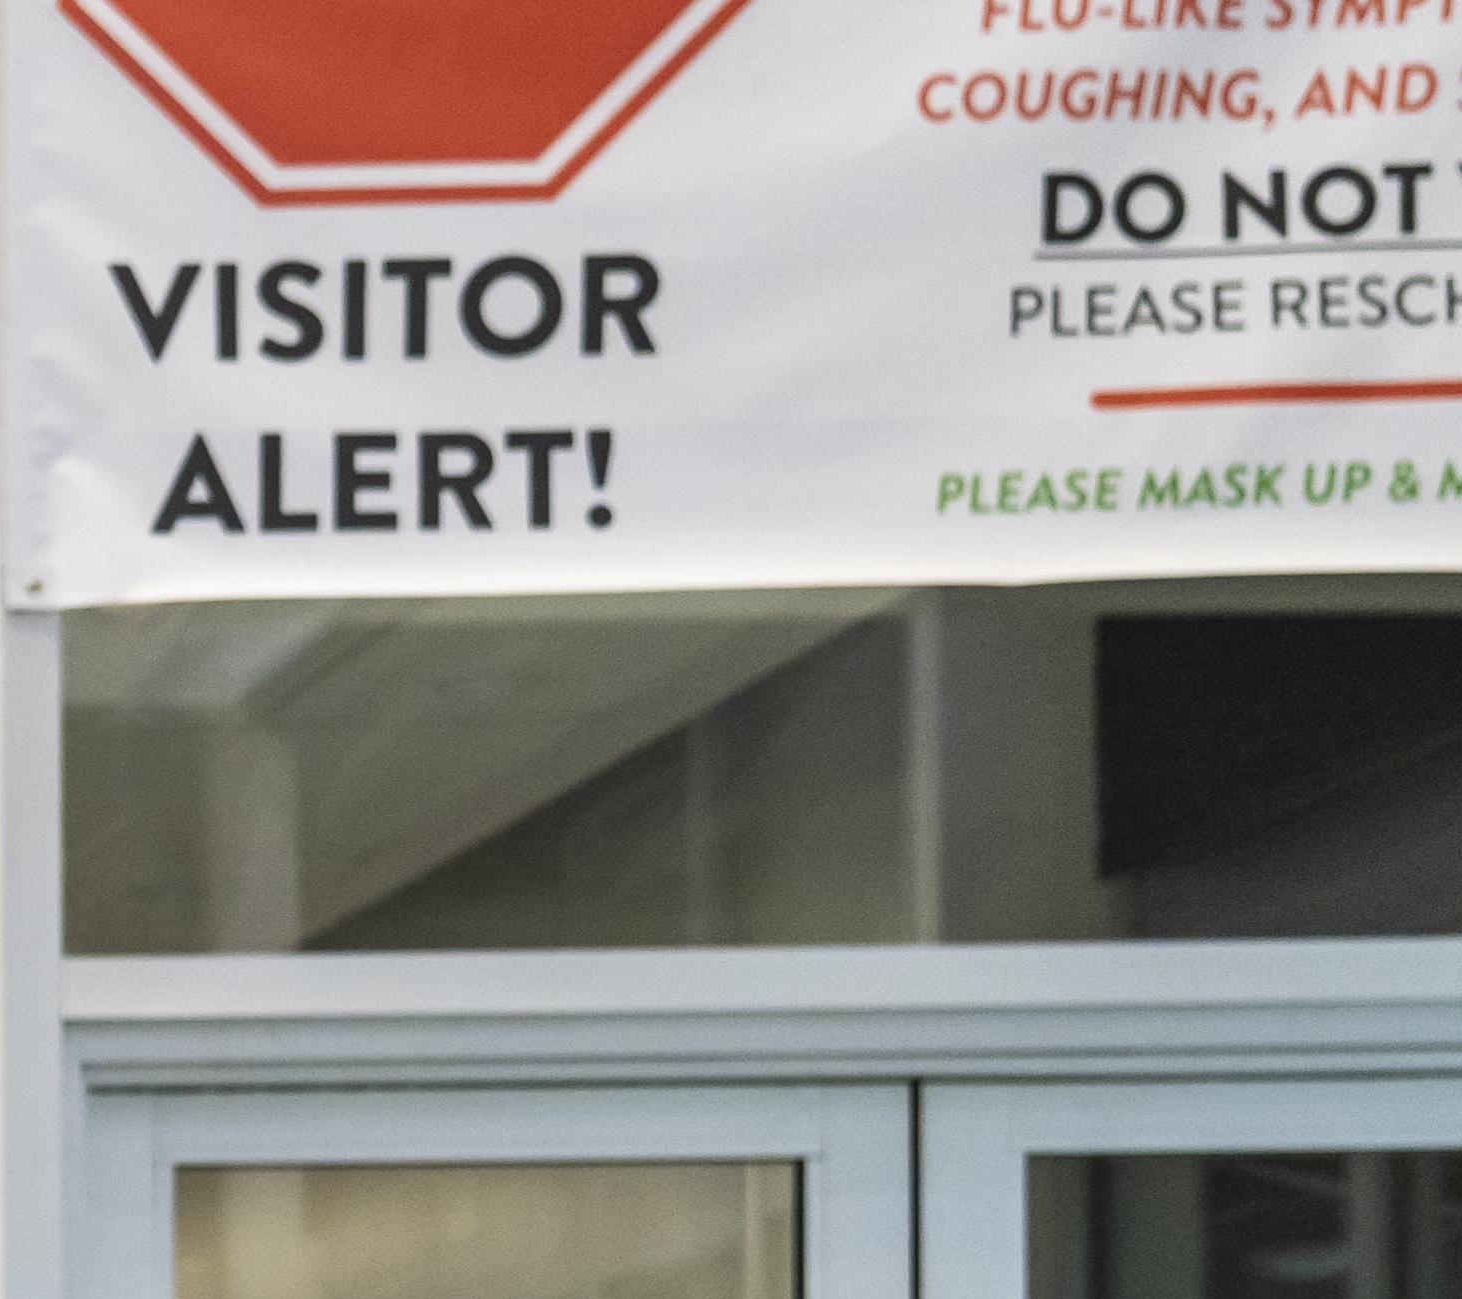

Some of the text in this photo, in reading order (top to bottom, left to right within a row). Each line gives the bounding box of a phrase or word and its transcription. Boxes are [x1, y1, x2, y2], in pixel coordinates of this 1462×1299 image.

[916, 62, 1439, 131] COUGHING, AND
[1042, 162, 1433, 243] DO NOT
[109, 254, 662, 361] VISITOR
[1010, 280, 1245, 337] PLEASE
[152, 428, 614, 535] ALERT!
[937, 468, 1121, 514] PLEASE
[1138, 463, 1285, 509] MASK
[1304, 460, 1373, 505] UP
[1388, 459, 1420, 502] &
